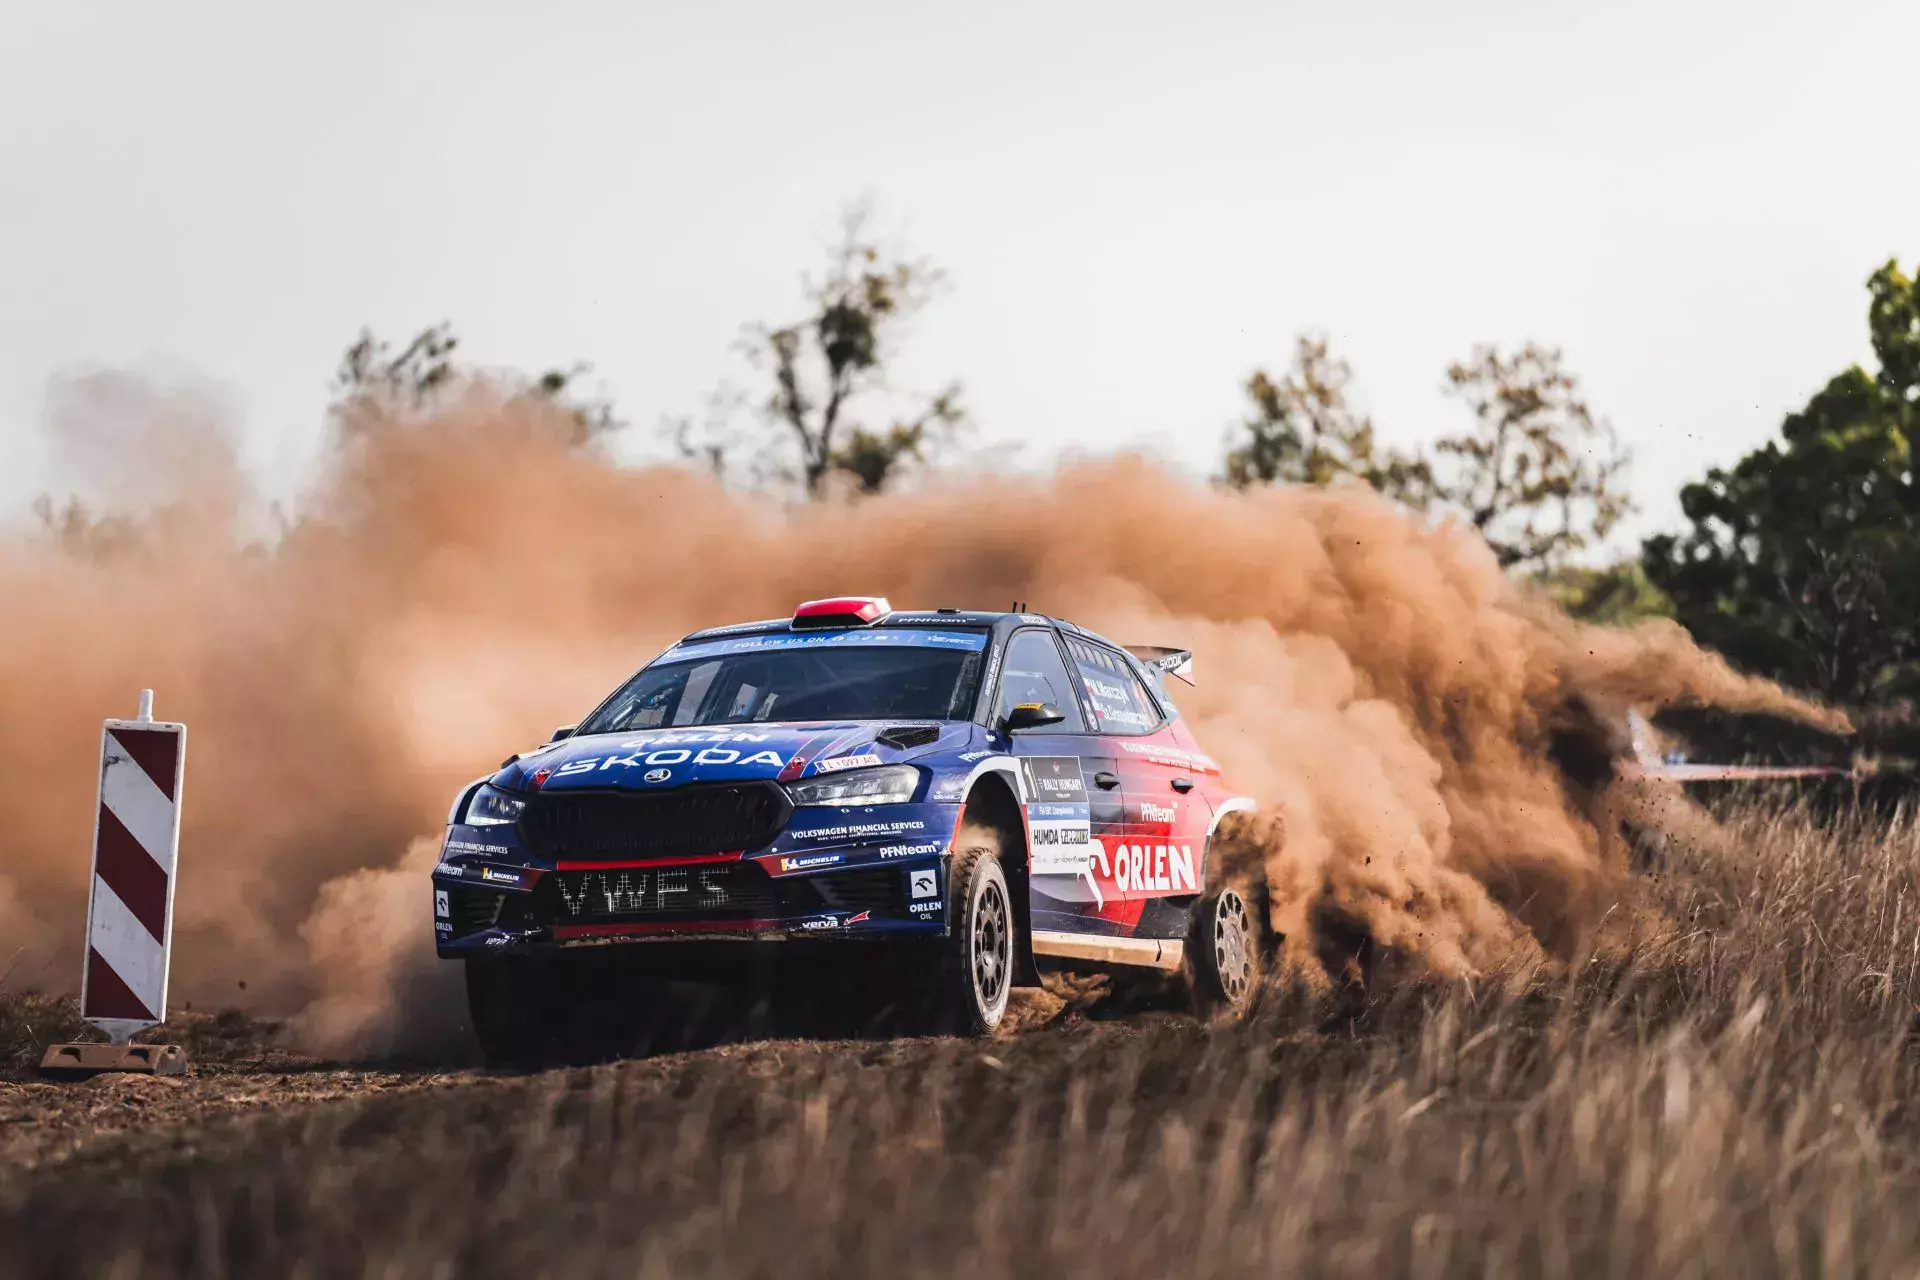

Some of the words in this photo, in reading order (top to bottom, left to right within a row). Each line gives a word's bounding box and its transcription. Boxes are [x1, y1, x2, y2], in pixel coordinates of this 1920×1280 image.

[1042, 778, 1058, 791] RALLY
[1058, 778, 1082, 791] HUNGARY
[791, 826, 847, 839] VOLKSWAGEN
[849, 823, 890, 834] FINANCIAL
[890, 821, 925, 831] SERVICES
[1033, 829, 1059, 845] HUMDA
[485, 845, 508, 855] SERVICES
[879, 843, 937, 859] PFNteam
[799, 855, 840, 866] MICHELIN
[1114, 844, 1196, 892] ORLEN
[493, 872, 520, 881] MICHELIN
[909, 901, 942, 913] ORLEN
